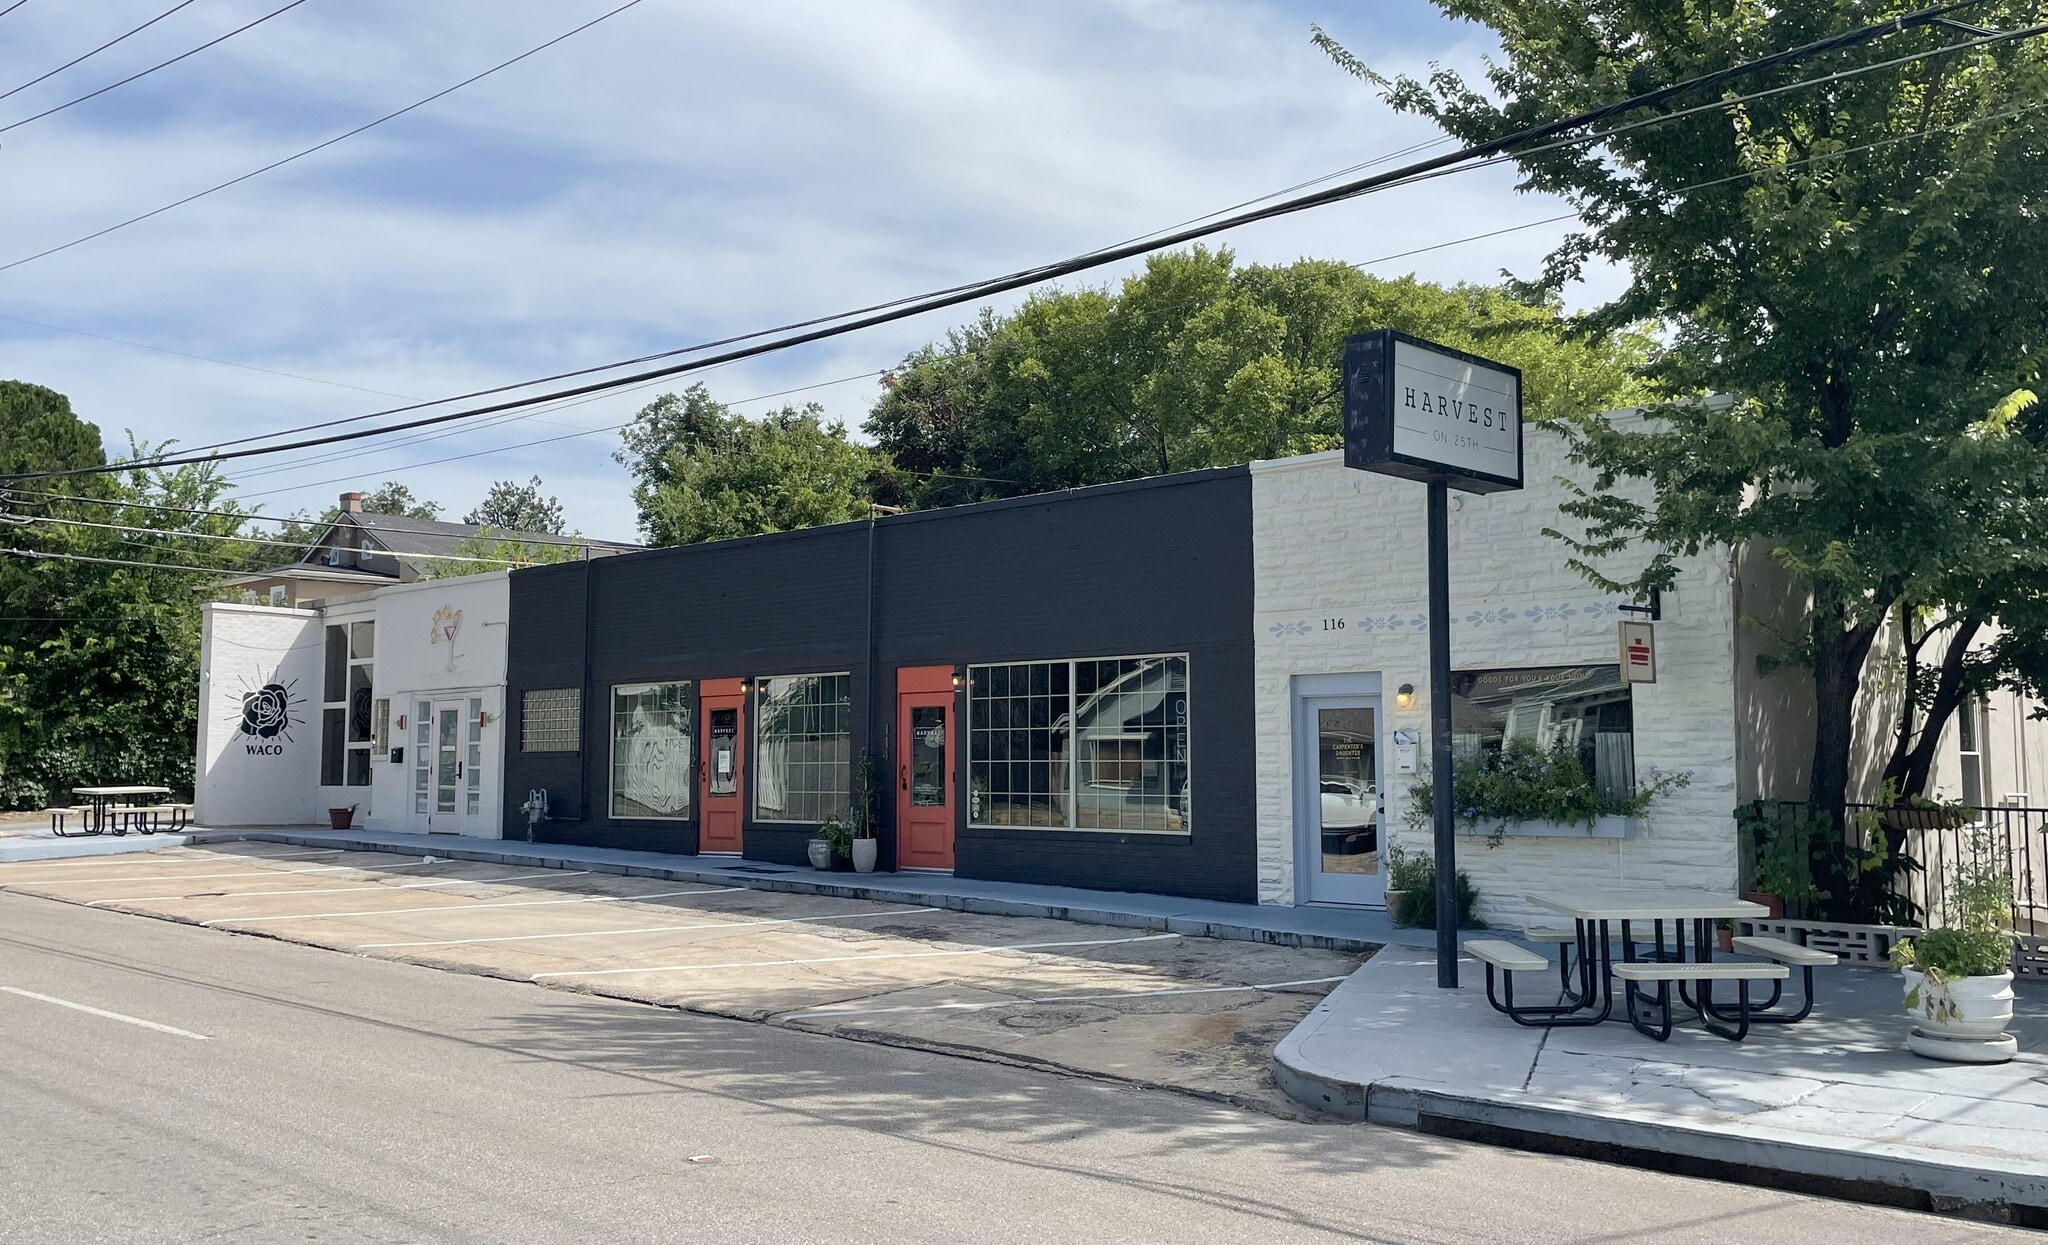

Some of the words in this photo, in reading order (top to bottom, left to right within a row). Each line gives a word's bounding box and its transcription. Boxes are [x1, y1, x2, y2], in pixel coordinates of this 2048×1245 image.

[1404, 386, 1507, 432] HARVEST
[1433, 429, 1448, 444] ON
[1454, 434, 1480, 451] 25TH
[1323, 618, 1345, 631] 116
[1477, 676, 1502, 684] GOODS
[1505, 675, 1519, 683] FOR
[1521, 674, 1537, 682] YOU
[1175, 699, 1186, 764] OPEN
[245, 744, 283, 756] WACO
